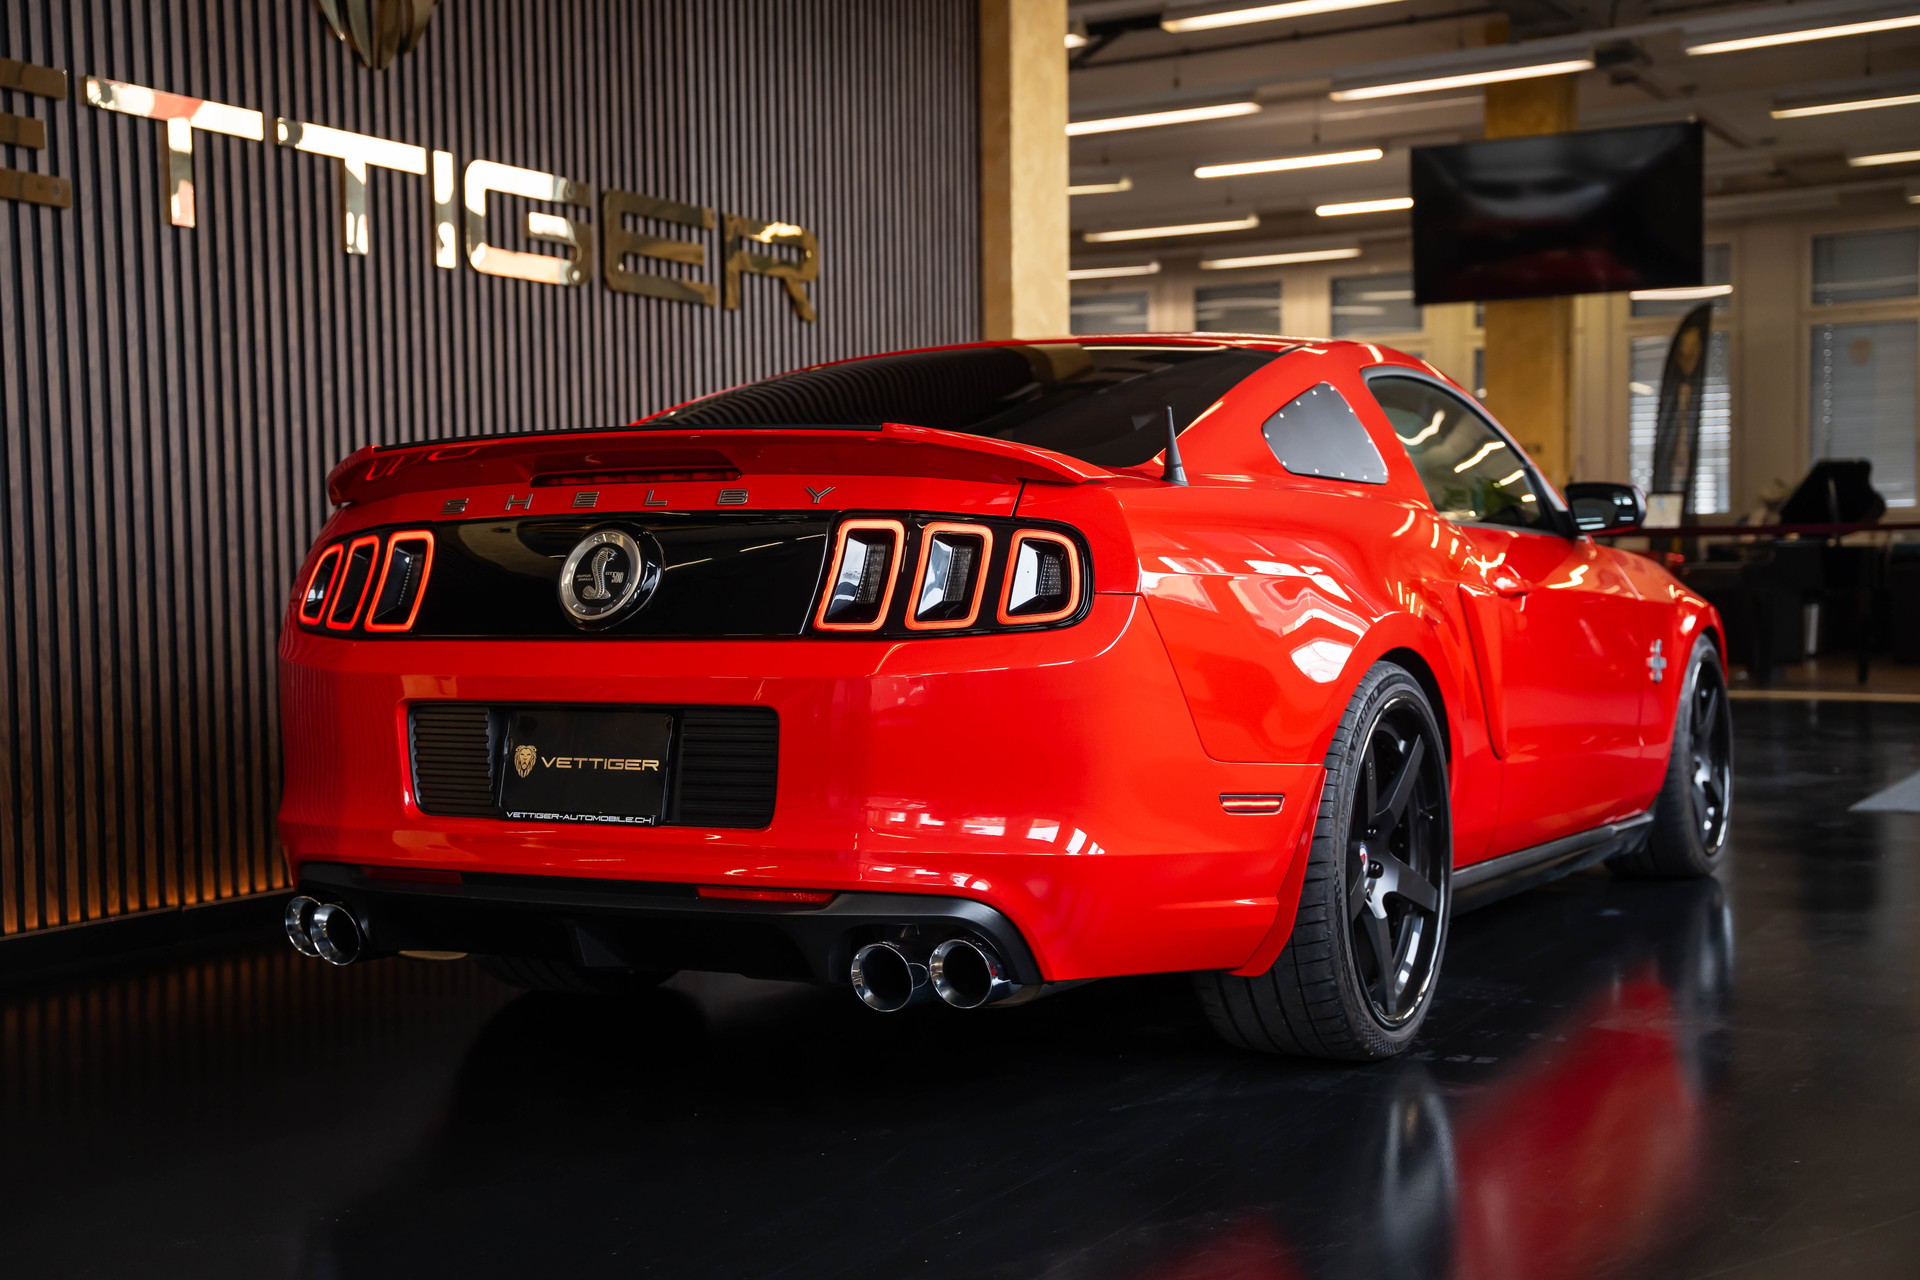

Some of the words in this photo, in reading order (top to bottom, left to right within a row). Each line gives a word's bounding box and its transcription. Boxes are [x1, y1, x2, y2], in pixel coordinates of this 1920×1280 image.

[441, 486, 836, 514] SHELBY
[541, 757, 660, 771] VETTIGER
[506, 811, 652, 824] VETTIGER-AUTOMOBILE.CH
